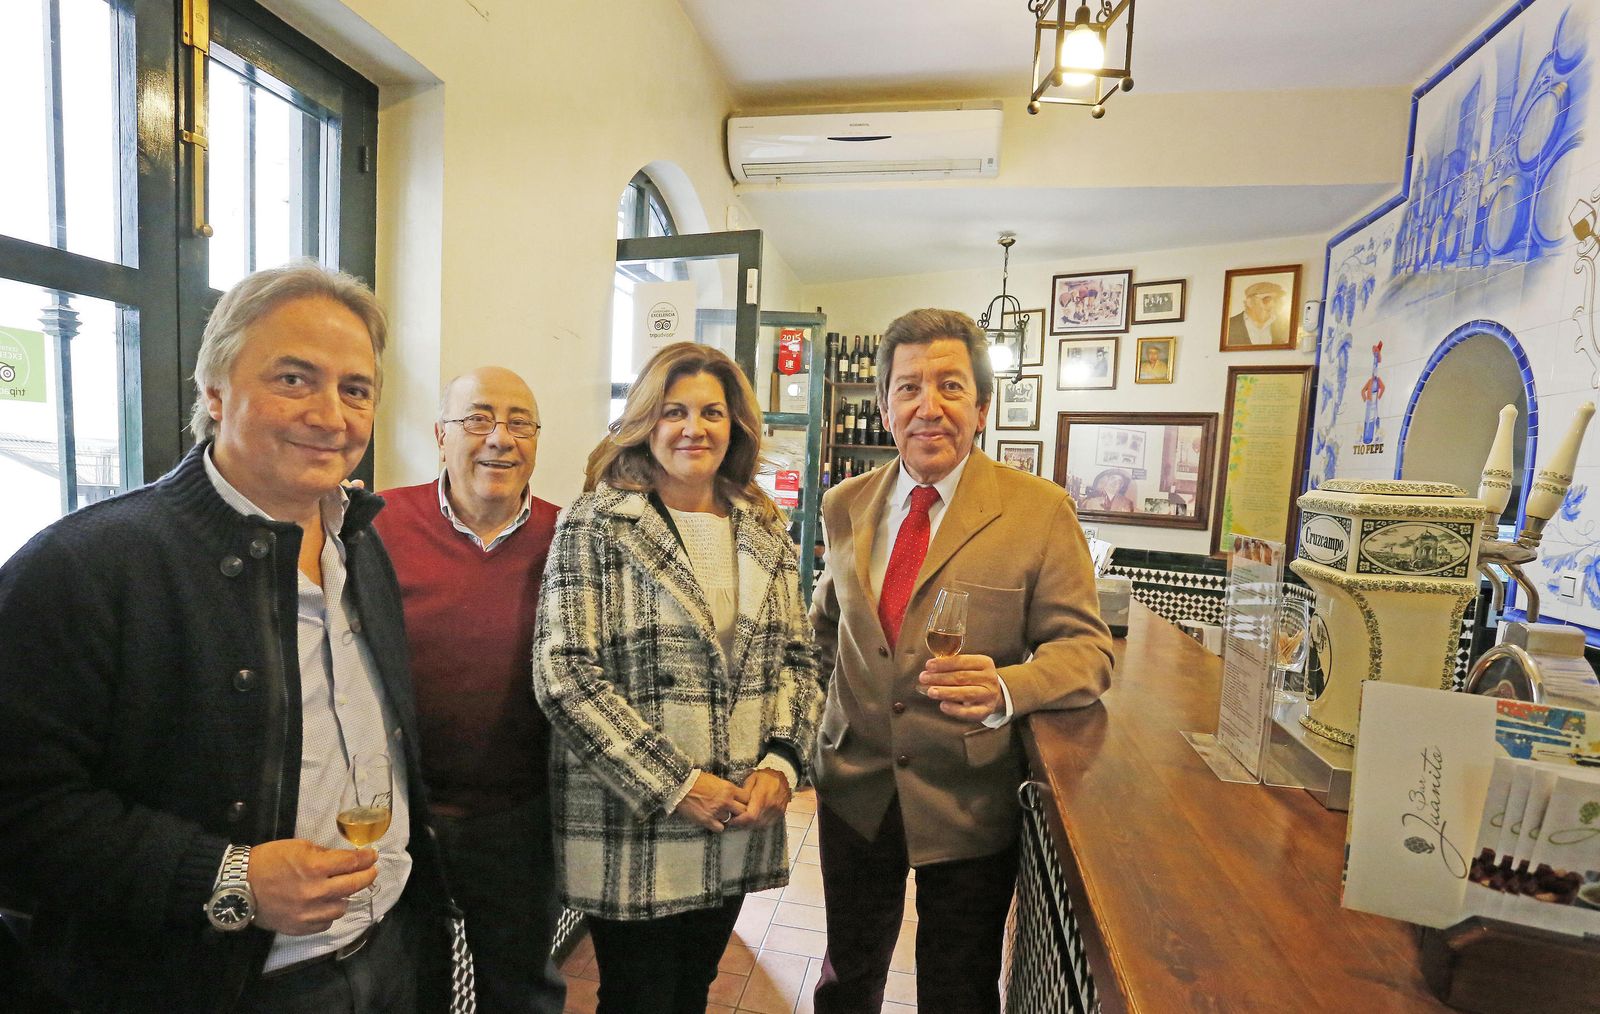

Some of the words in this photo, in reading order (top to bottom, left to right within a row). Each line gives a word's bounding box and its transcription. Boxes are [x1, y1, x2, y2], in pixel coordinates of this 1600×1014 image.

[782, 332, 802, 341] 2015
[1366, 443, 1385, 454] PEPE
[1305, 526, 1344, 556] Cruzcampo
[1409, 775, 1428, 811] Bar
[1402, 745, 1468, 879] Juanito
